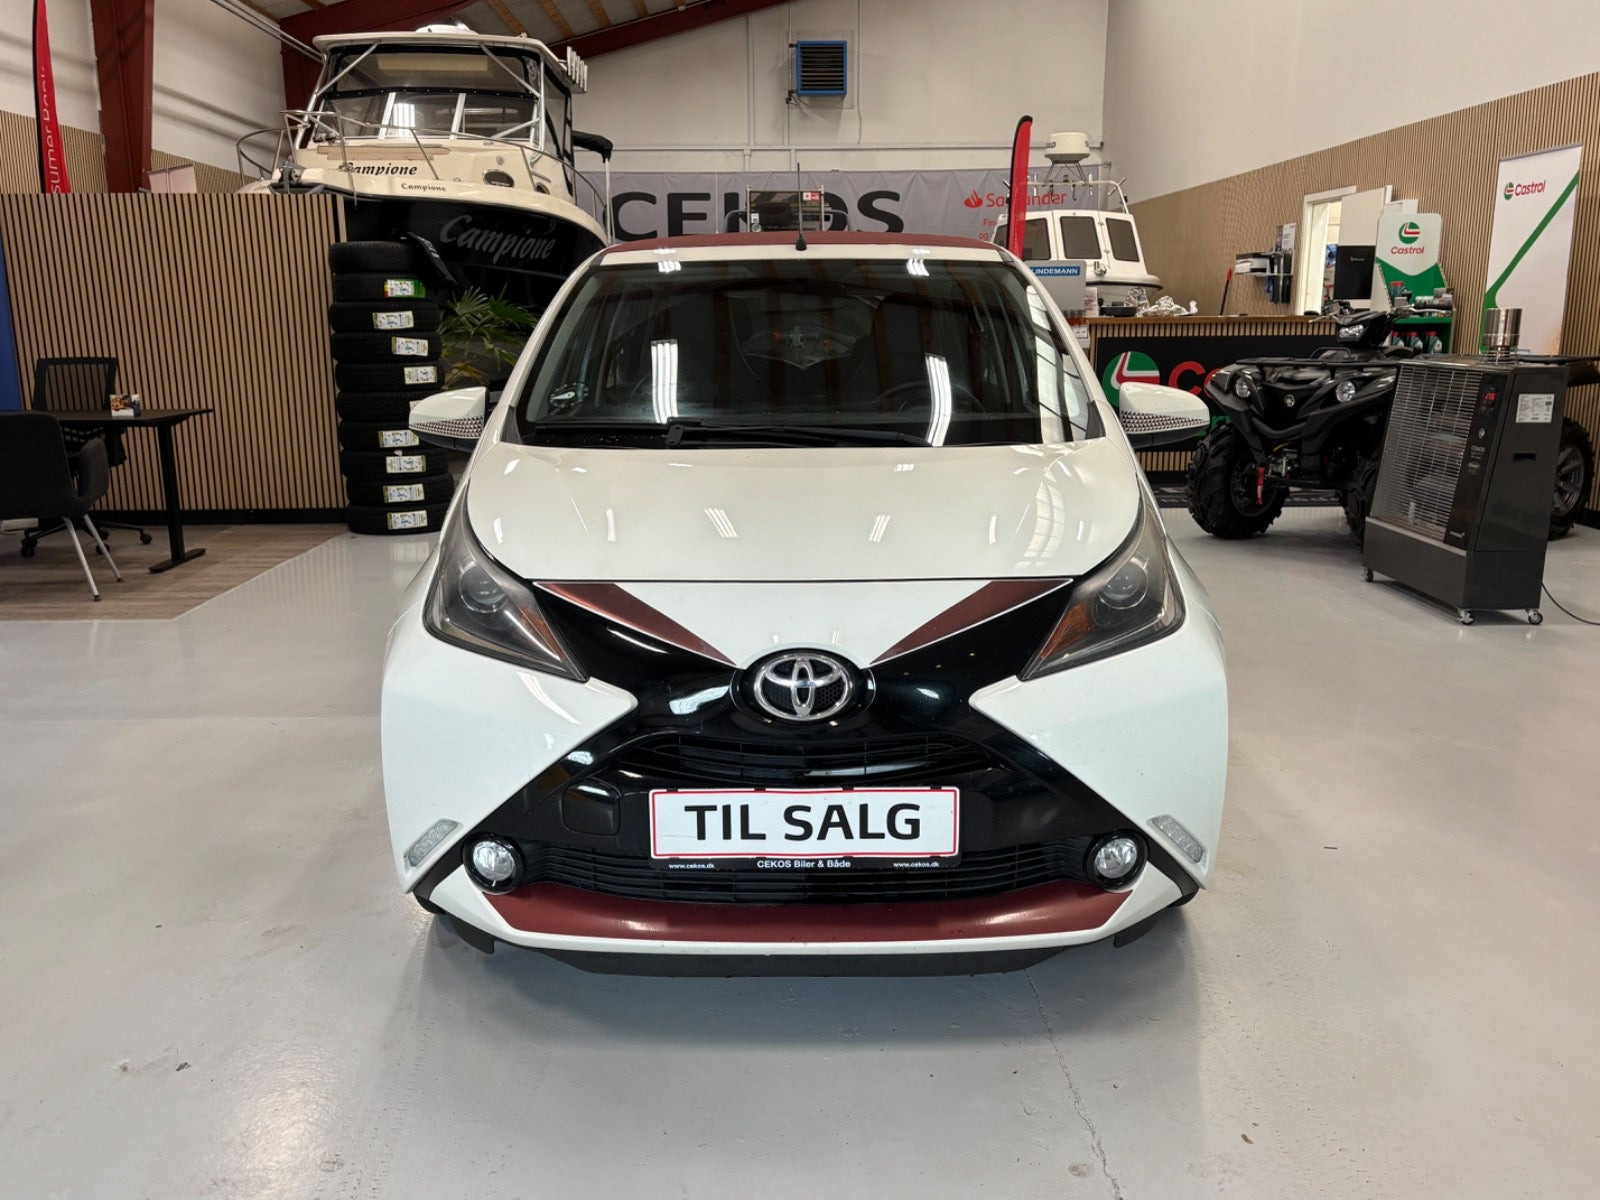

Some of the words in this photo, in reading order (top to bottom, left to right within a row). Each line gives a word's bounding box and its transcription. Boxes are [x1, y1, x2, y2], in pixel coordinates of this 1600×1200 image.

[1514, 180, 1546, 196] Castrol
[439, 214, 556, 264] Campione
[1390, 246, 1425, 255] Castrol
[684, 803, 767, 841] TIL
[783, 803, 921, 842] SALG
[757, 860, 792, 869] CEKOS
[794, 859, 814, 869] Biler
[817, 860, 824, 869] &
[827, 859, 851, 869] Både
